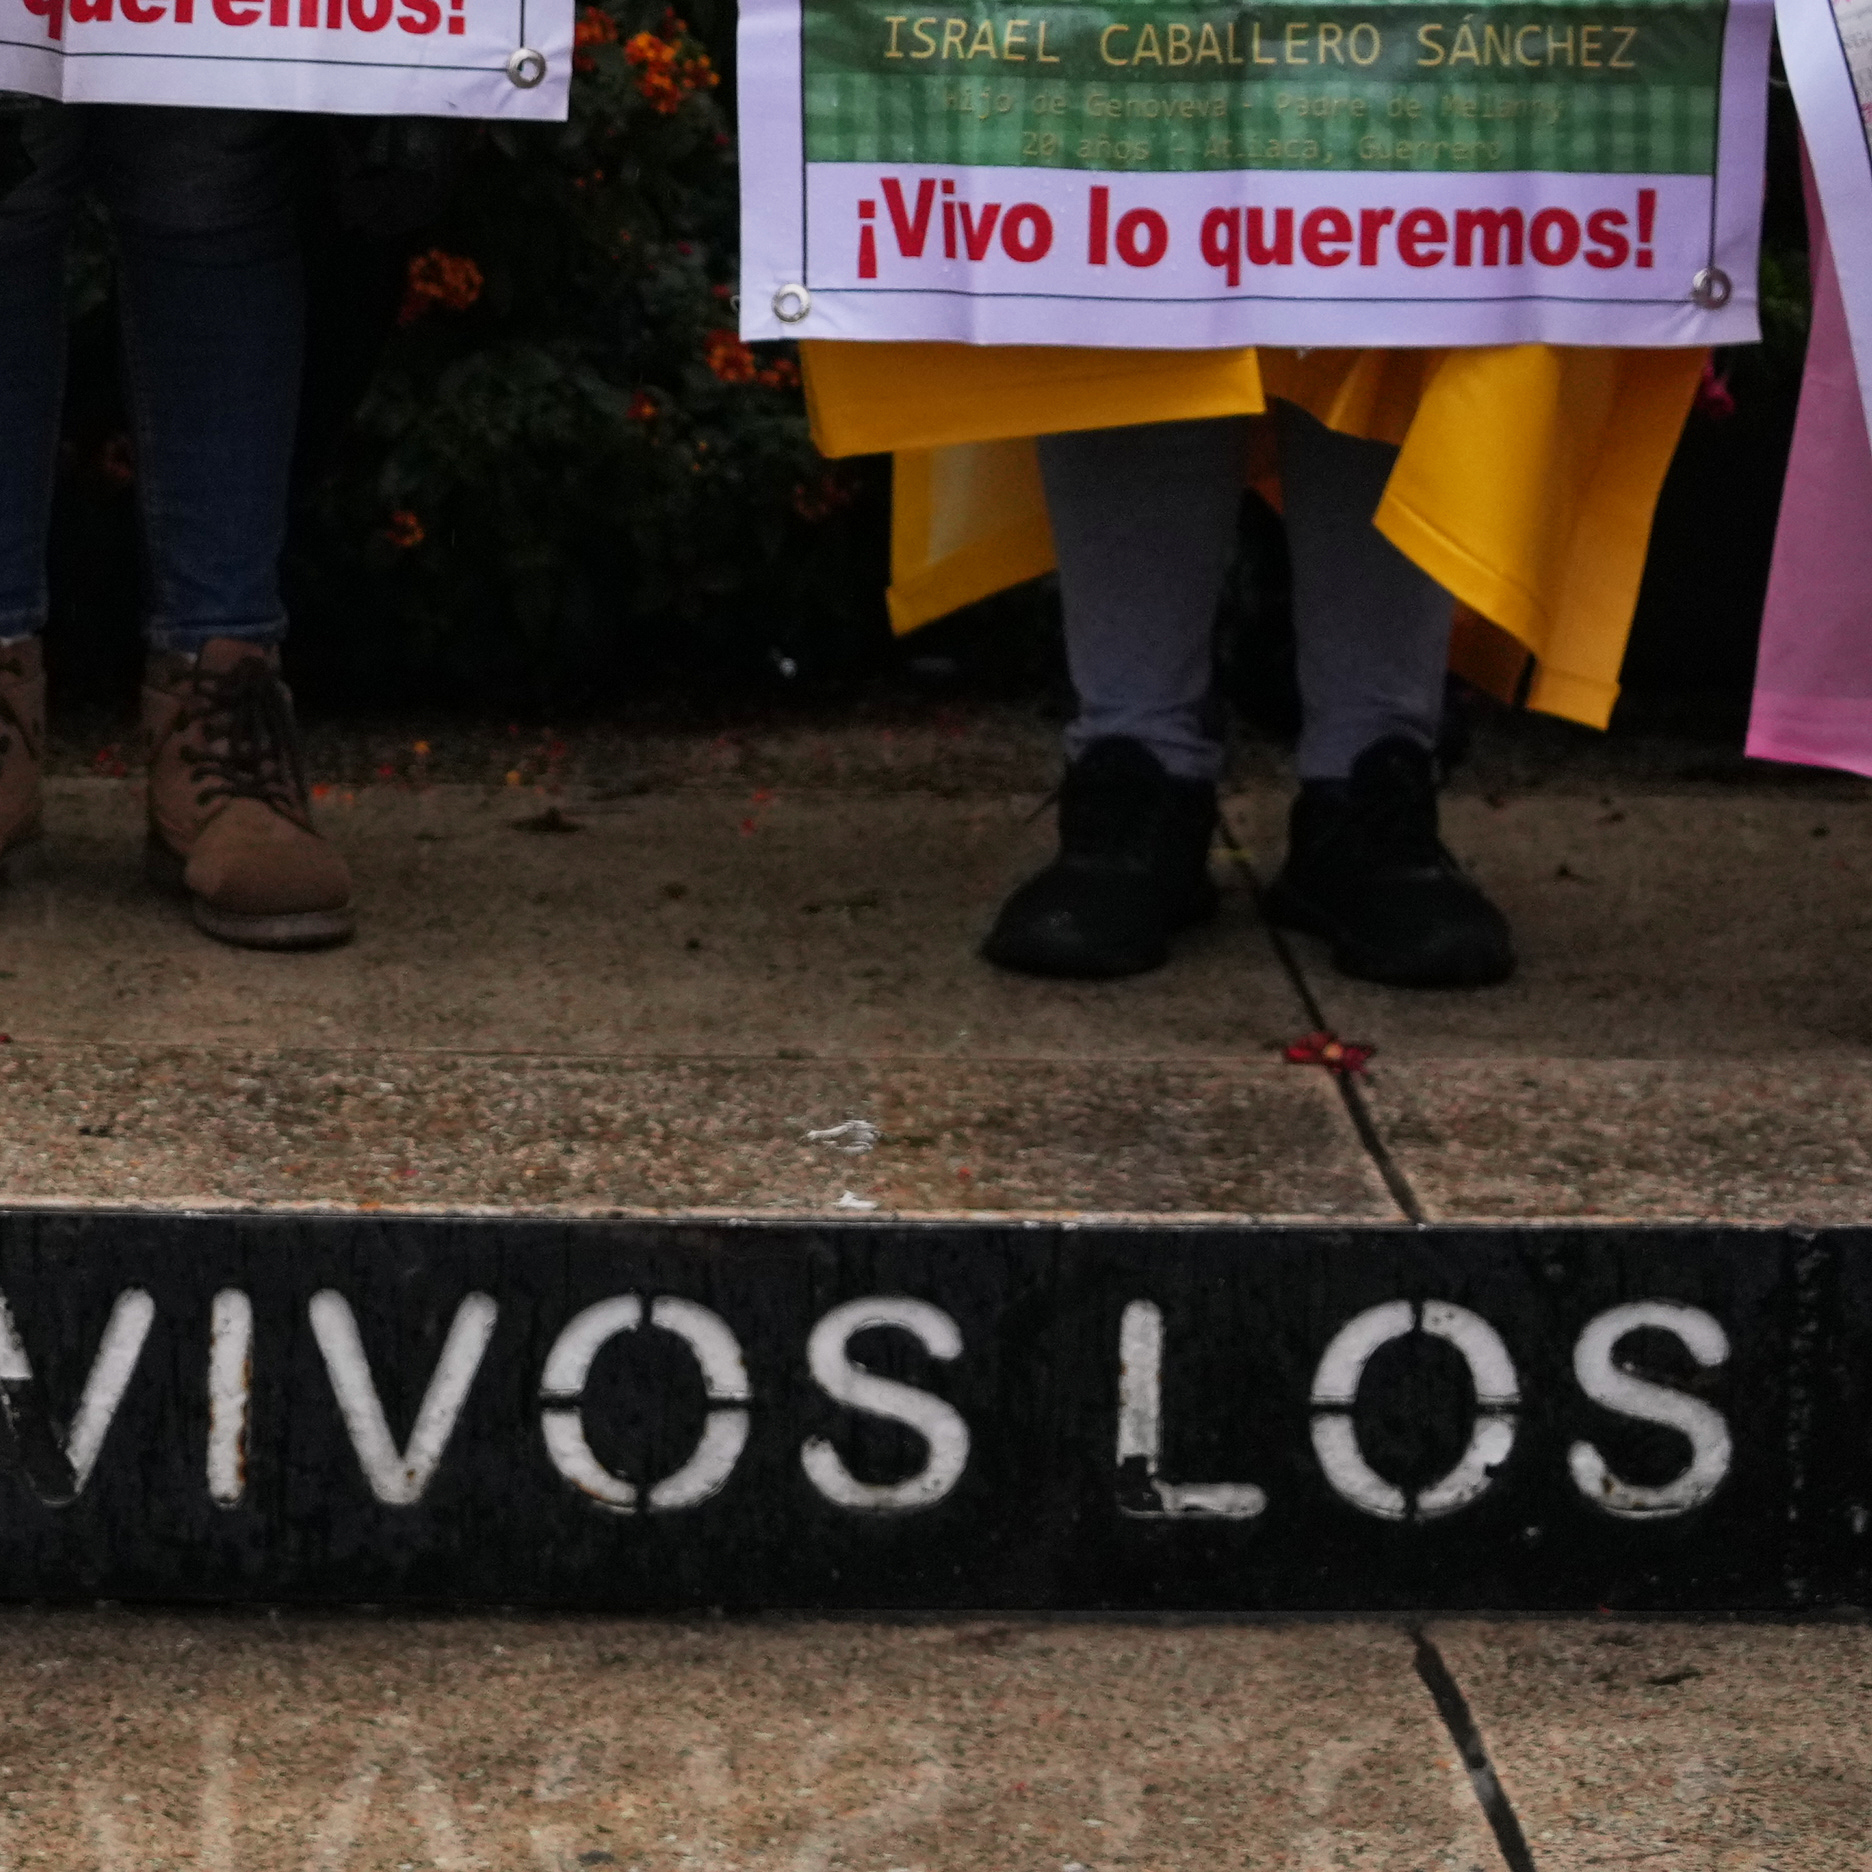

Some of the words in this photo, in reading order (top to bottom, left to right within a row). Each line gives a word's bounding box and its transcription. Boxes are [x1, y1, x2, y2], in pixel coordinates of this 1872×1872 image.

[883, 16, 1060, 64] ISRAEL
[1100, 21, 1381, 66] CABALLERO
[1417, 13, 1640, 69] SÁNCHEZ
[1032, 91, 1068, 115] de
[857, 177, 1053, 279] ¡Vivo
[1087, 185, 1169, 267] lo
[1199, 188, 1657, 287] queremos!
[1116, 1299, 1734, 1521] LOS
